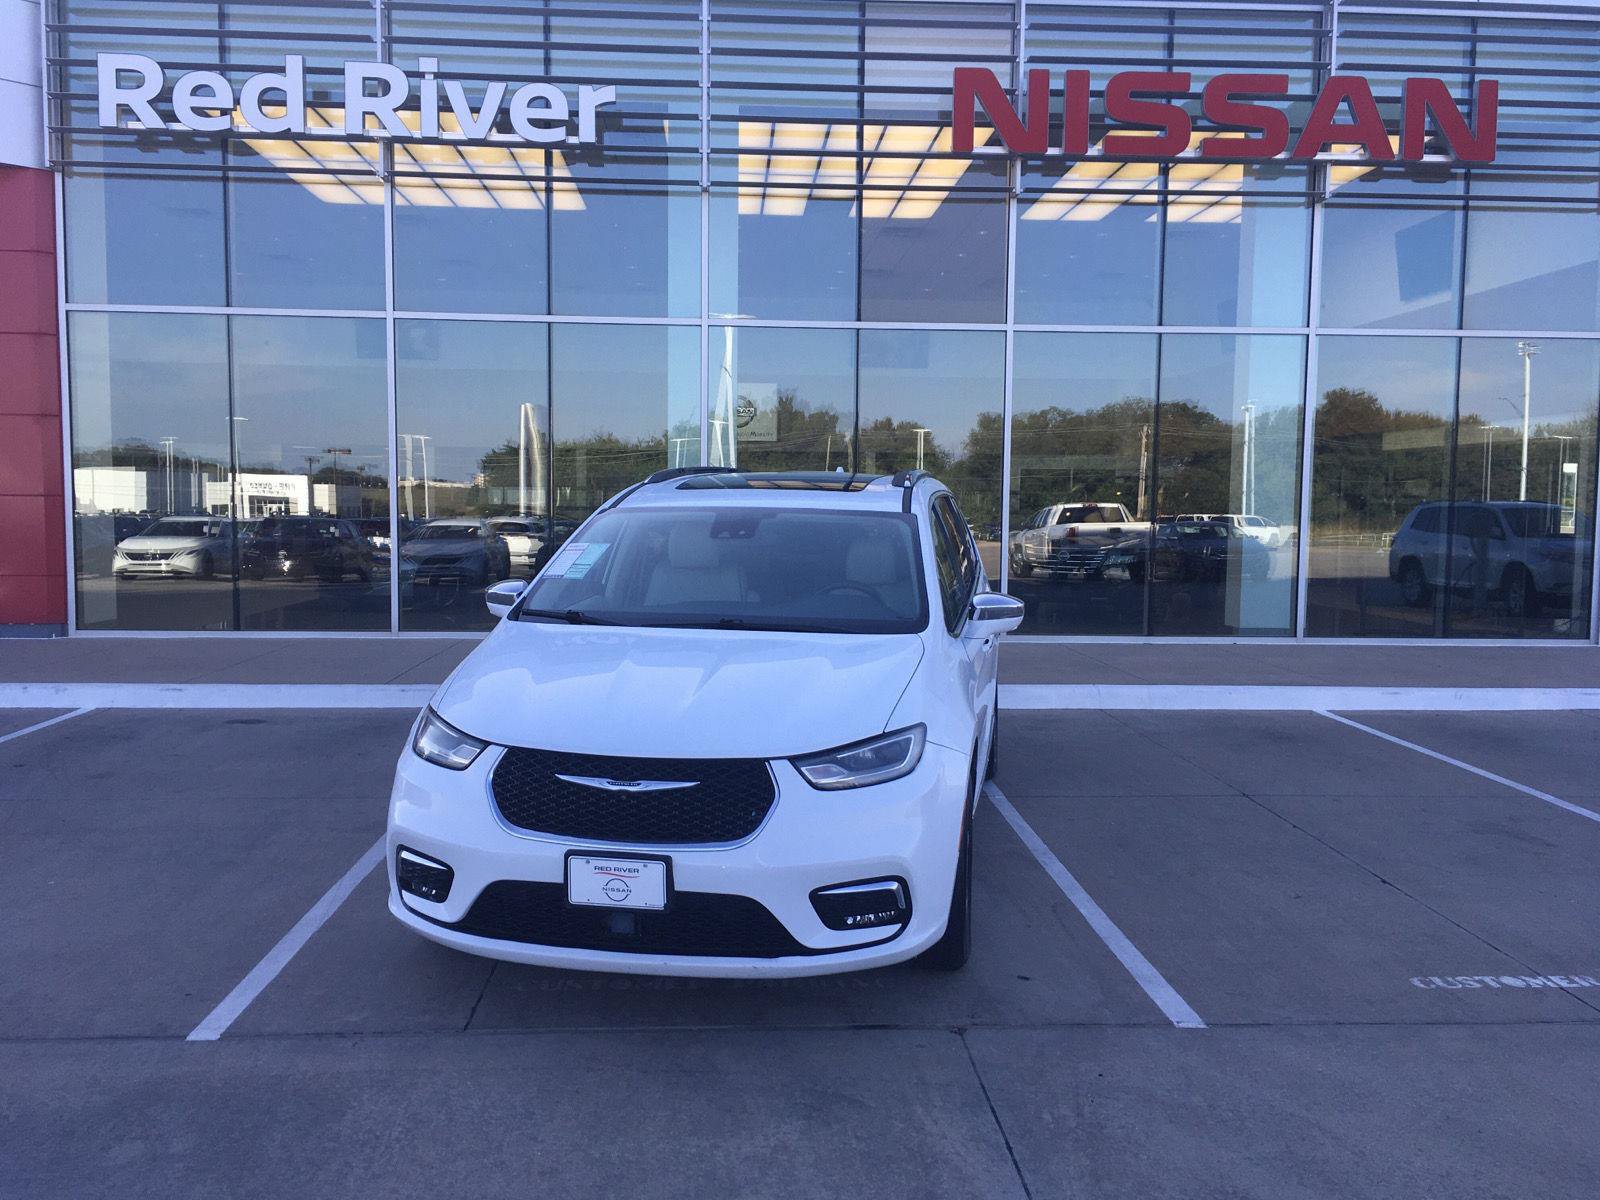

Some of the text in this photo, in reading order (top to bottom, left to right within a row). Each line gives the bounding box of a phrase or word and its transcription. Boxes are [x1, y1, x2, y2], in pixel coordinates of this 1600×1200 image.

[97, 52, 616, 144] Red River
[951, 67, 1500, 163] NISSAN
[602, 886, 632, 894] NISSAN
[613, 866, 640, 874] RIVER
